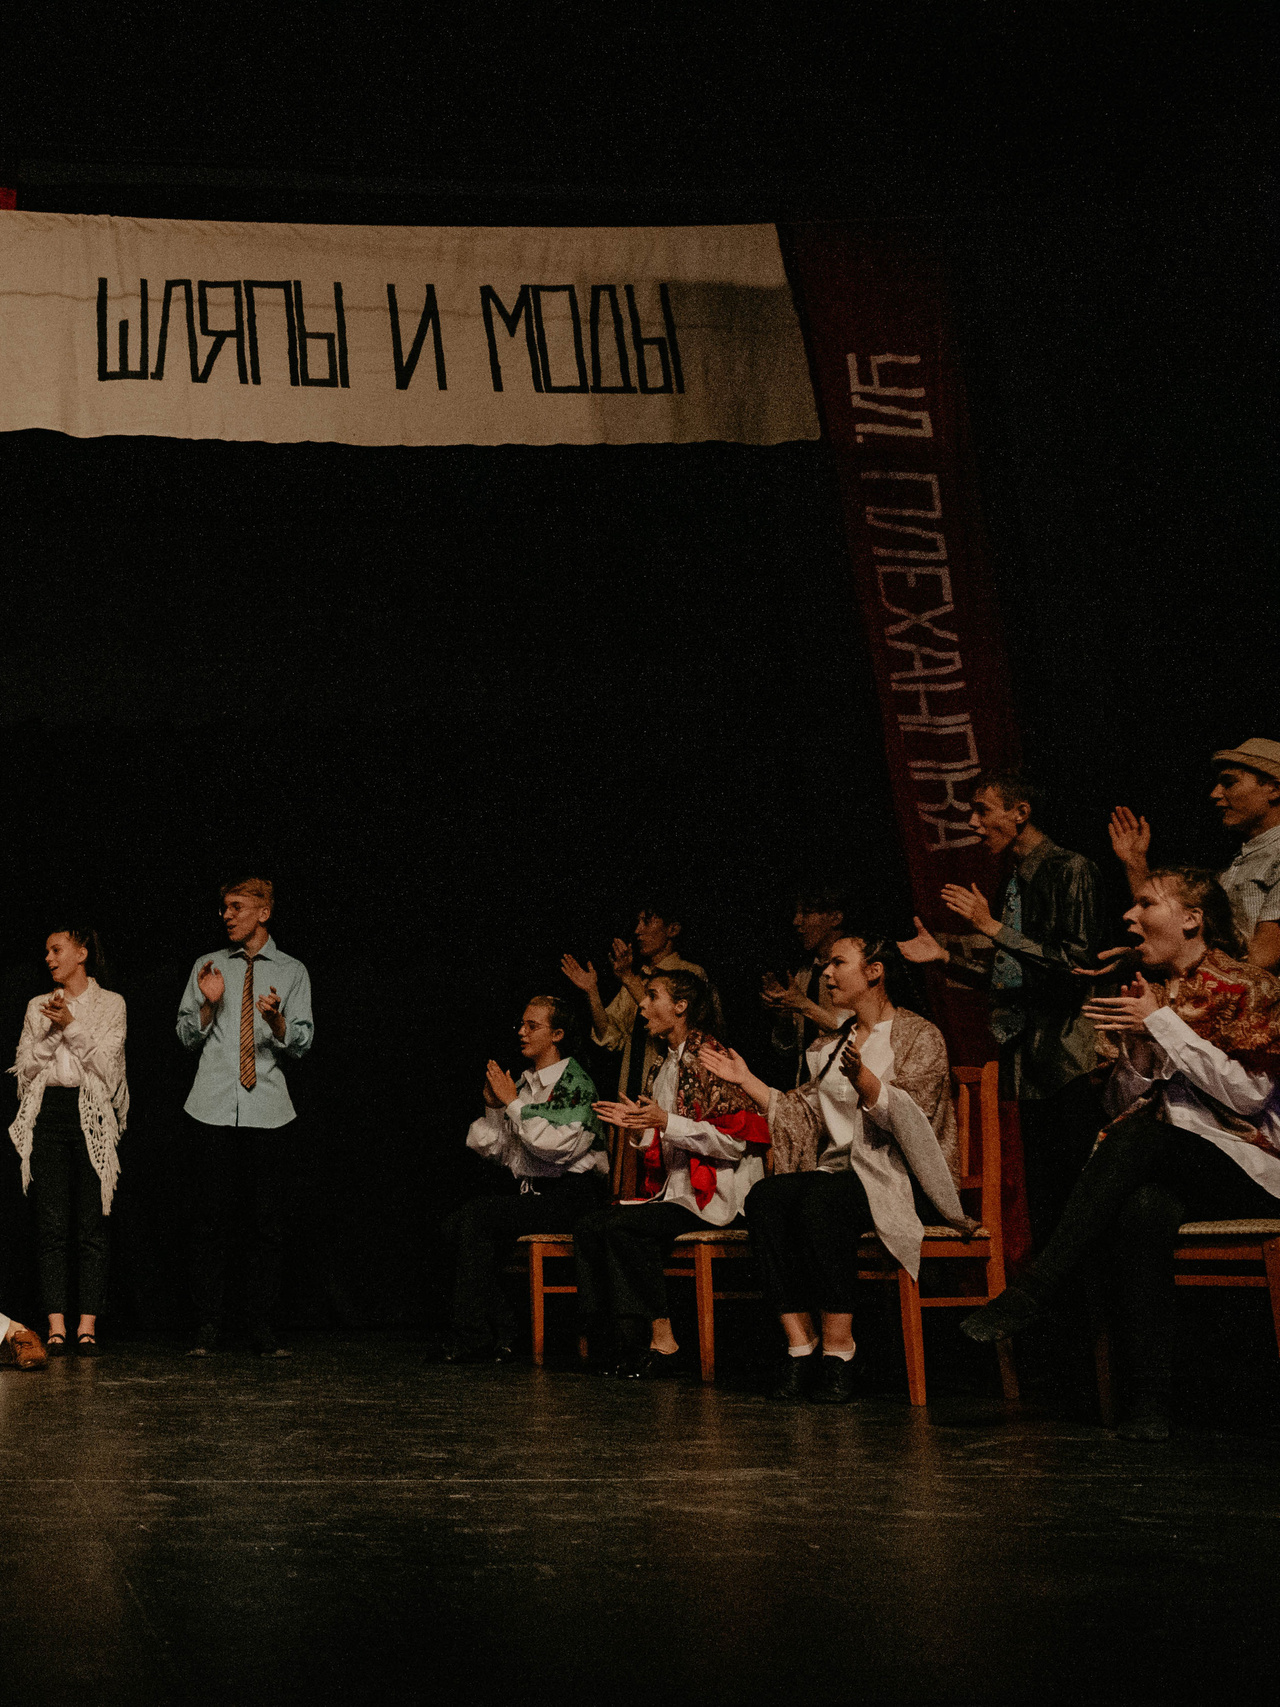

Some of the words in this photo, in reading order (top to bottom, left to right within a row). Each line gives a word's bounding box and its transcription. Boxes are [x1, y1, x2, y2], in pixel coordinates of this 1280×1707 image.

[96, 277, 351, 389] ШЛЯПЫ
[387, 283, 448, 391] И
[479, 283, 686, 395] МОДЫ
[846, 352, 934, 443] УЛ.
